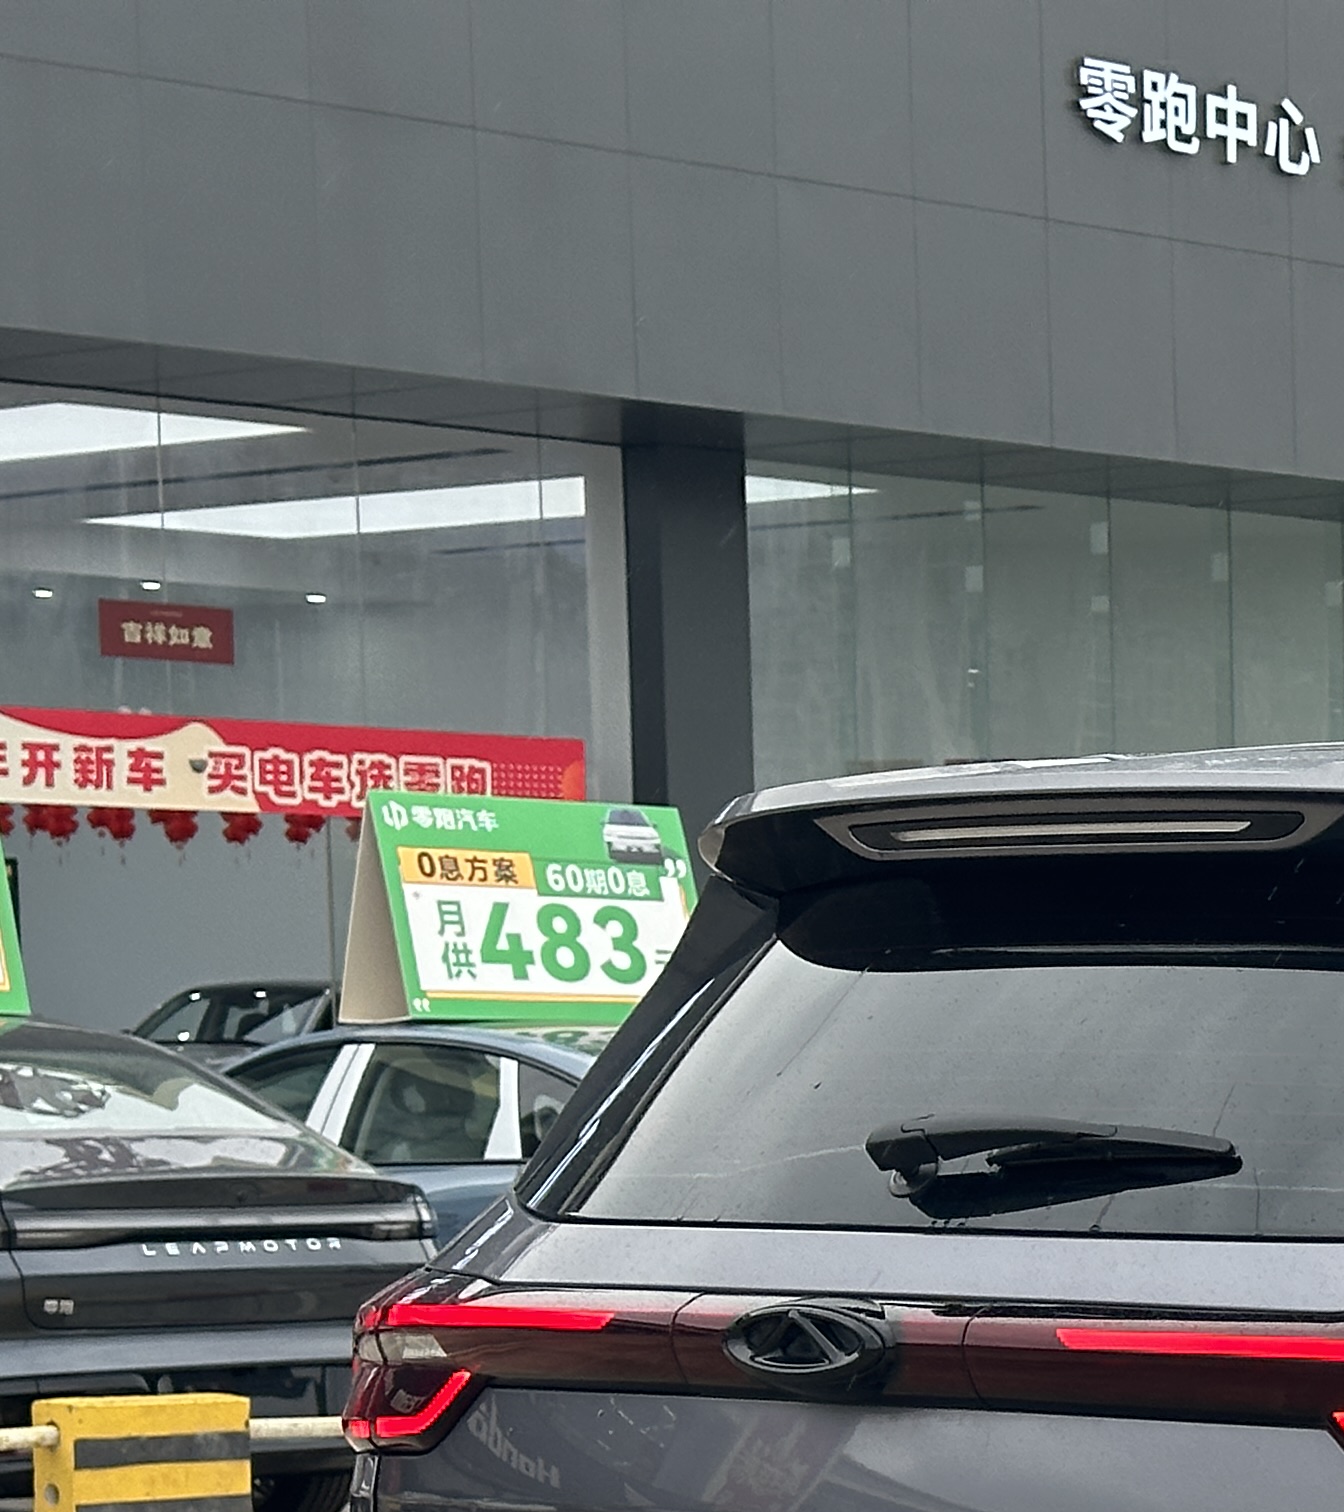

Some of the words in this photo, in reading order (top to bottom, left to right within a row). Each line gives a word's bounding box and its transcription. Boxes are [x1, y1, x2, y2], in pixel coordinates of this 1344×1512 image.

[1078, 57, 1321, 176] 零跑中心
[0, 742, 167, 792] 开新车
[411, 806, 499, 832] 零跑汽车
[418, 852, 518, 885] 0息方案
[547, 864, 650, 896] 60期0息
[480, 902, 647, 984] 483
[141, 1237, 341, 1257] LEAPMOTOR
